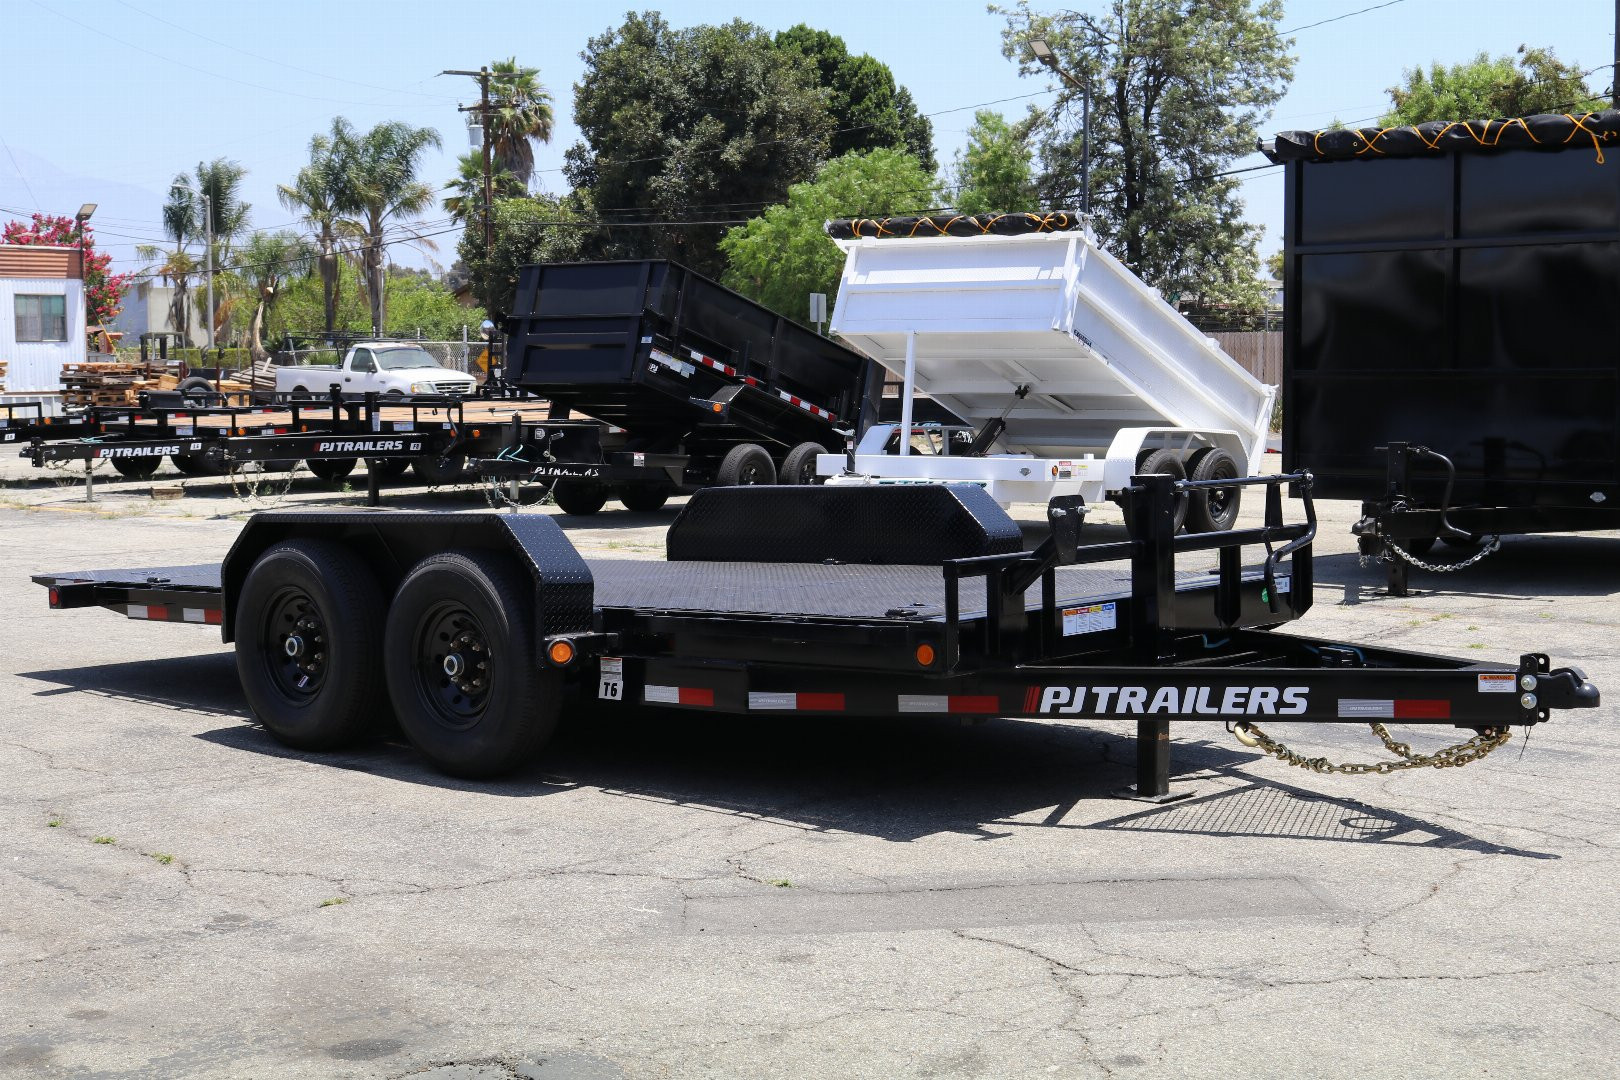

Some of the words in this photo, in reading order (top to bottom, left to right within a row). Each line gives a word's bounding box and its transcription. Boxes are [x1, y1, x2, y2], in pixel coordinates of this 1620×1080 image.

[603, 681, 618, 697] T6
[1039, 686, 1087, 714] PJ
[1090, 686, 1310, 715] TRAILERS
